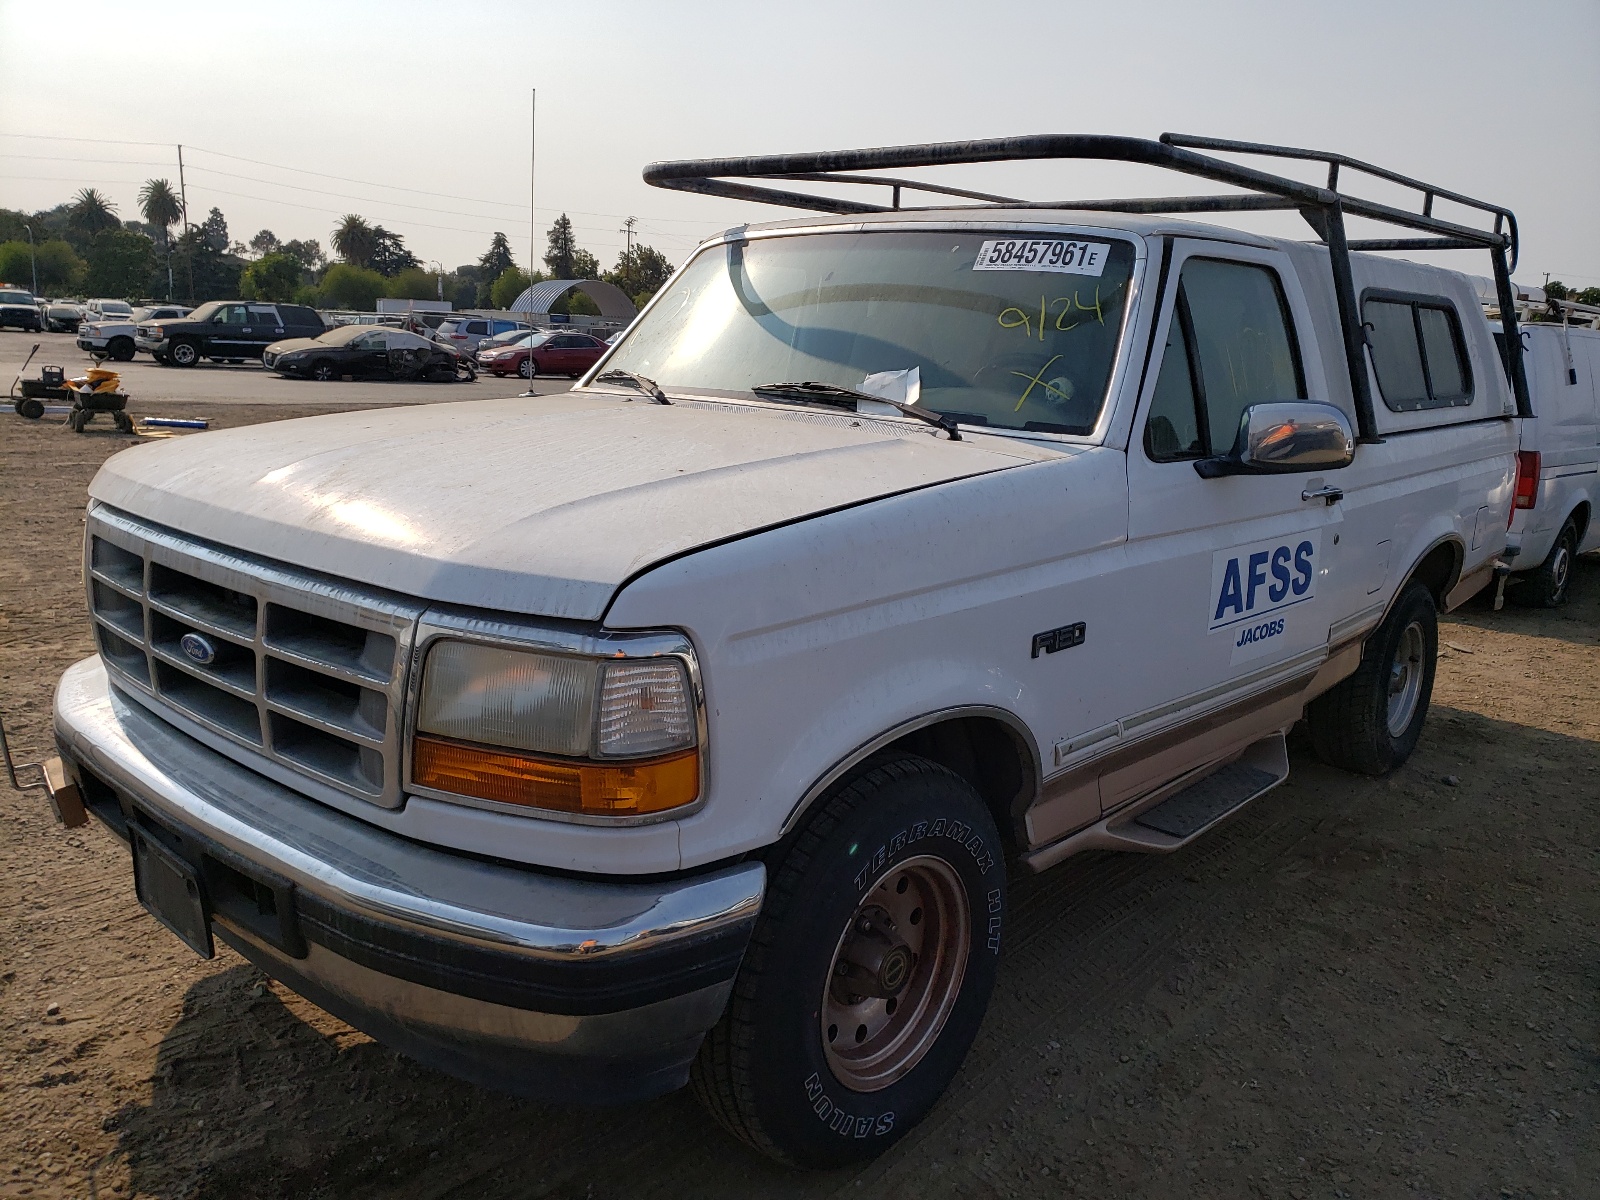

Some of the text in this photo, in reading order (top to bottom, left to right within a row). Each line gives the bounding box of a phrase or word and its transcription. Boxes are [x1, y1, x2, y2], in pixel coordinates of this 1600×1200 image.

[988, 241, 1089, 266] 58457961
[1088, 252, 1098, 265] E
[1214, 541, 1314, 620] AFSS
[186, 640, 204, 658] Ford
[1237, 618, 1284, 647] JACOBS
[853, 818, 1002, 955] TERRAMAX HLT
[804, 1071, 895, 1138] SAILUN
